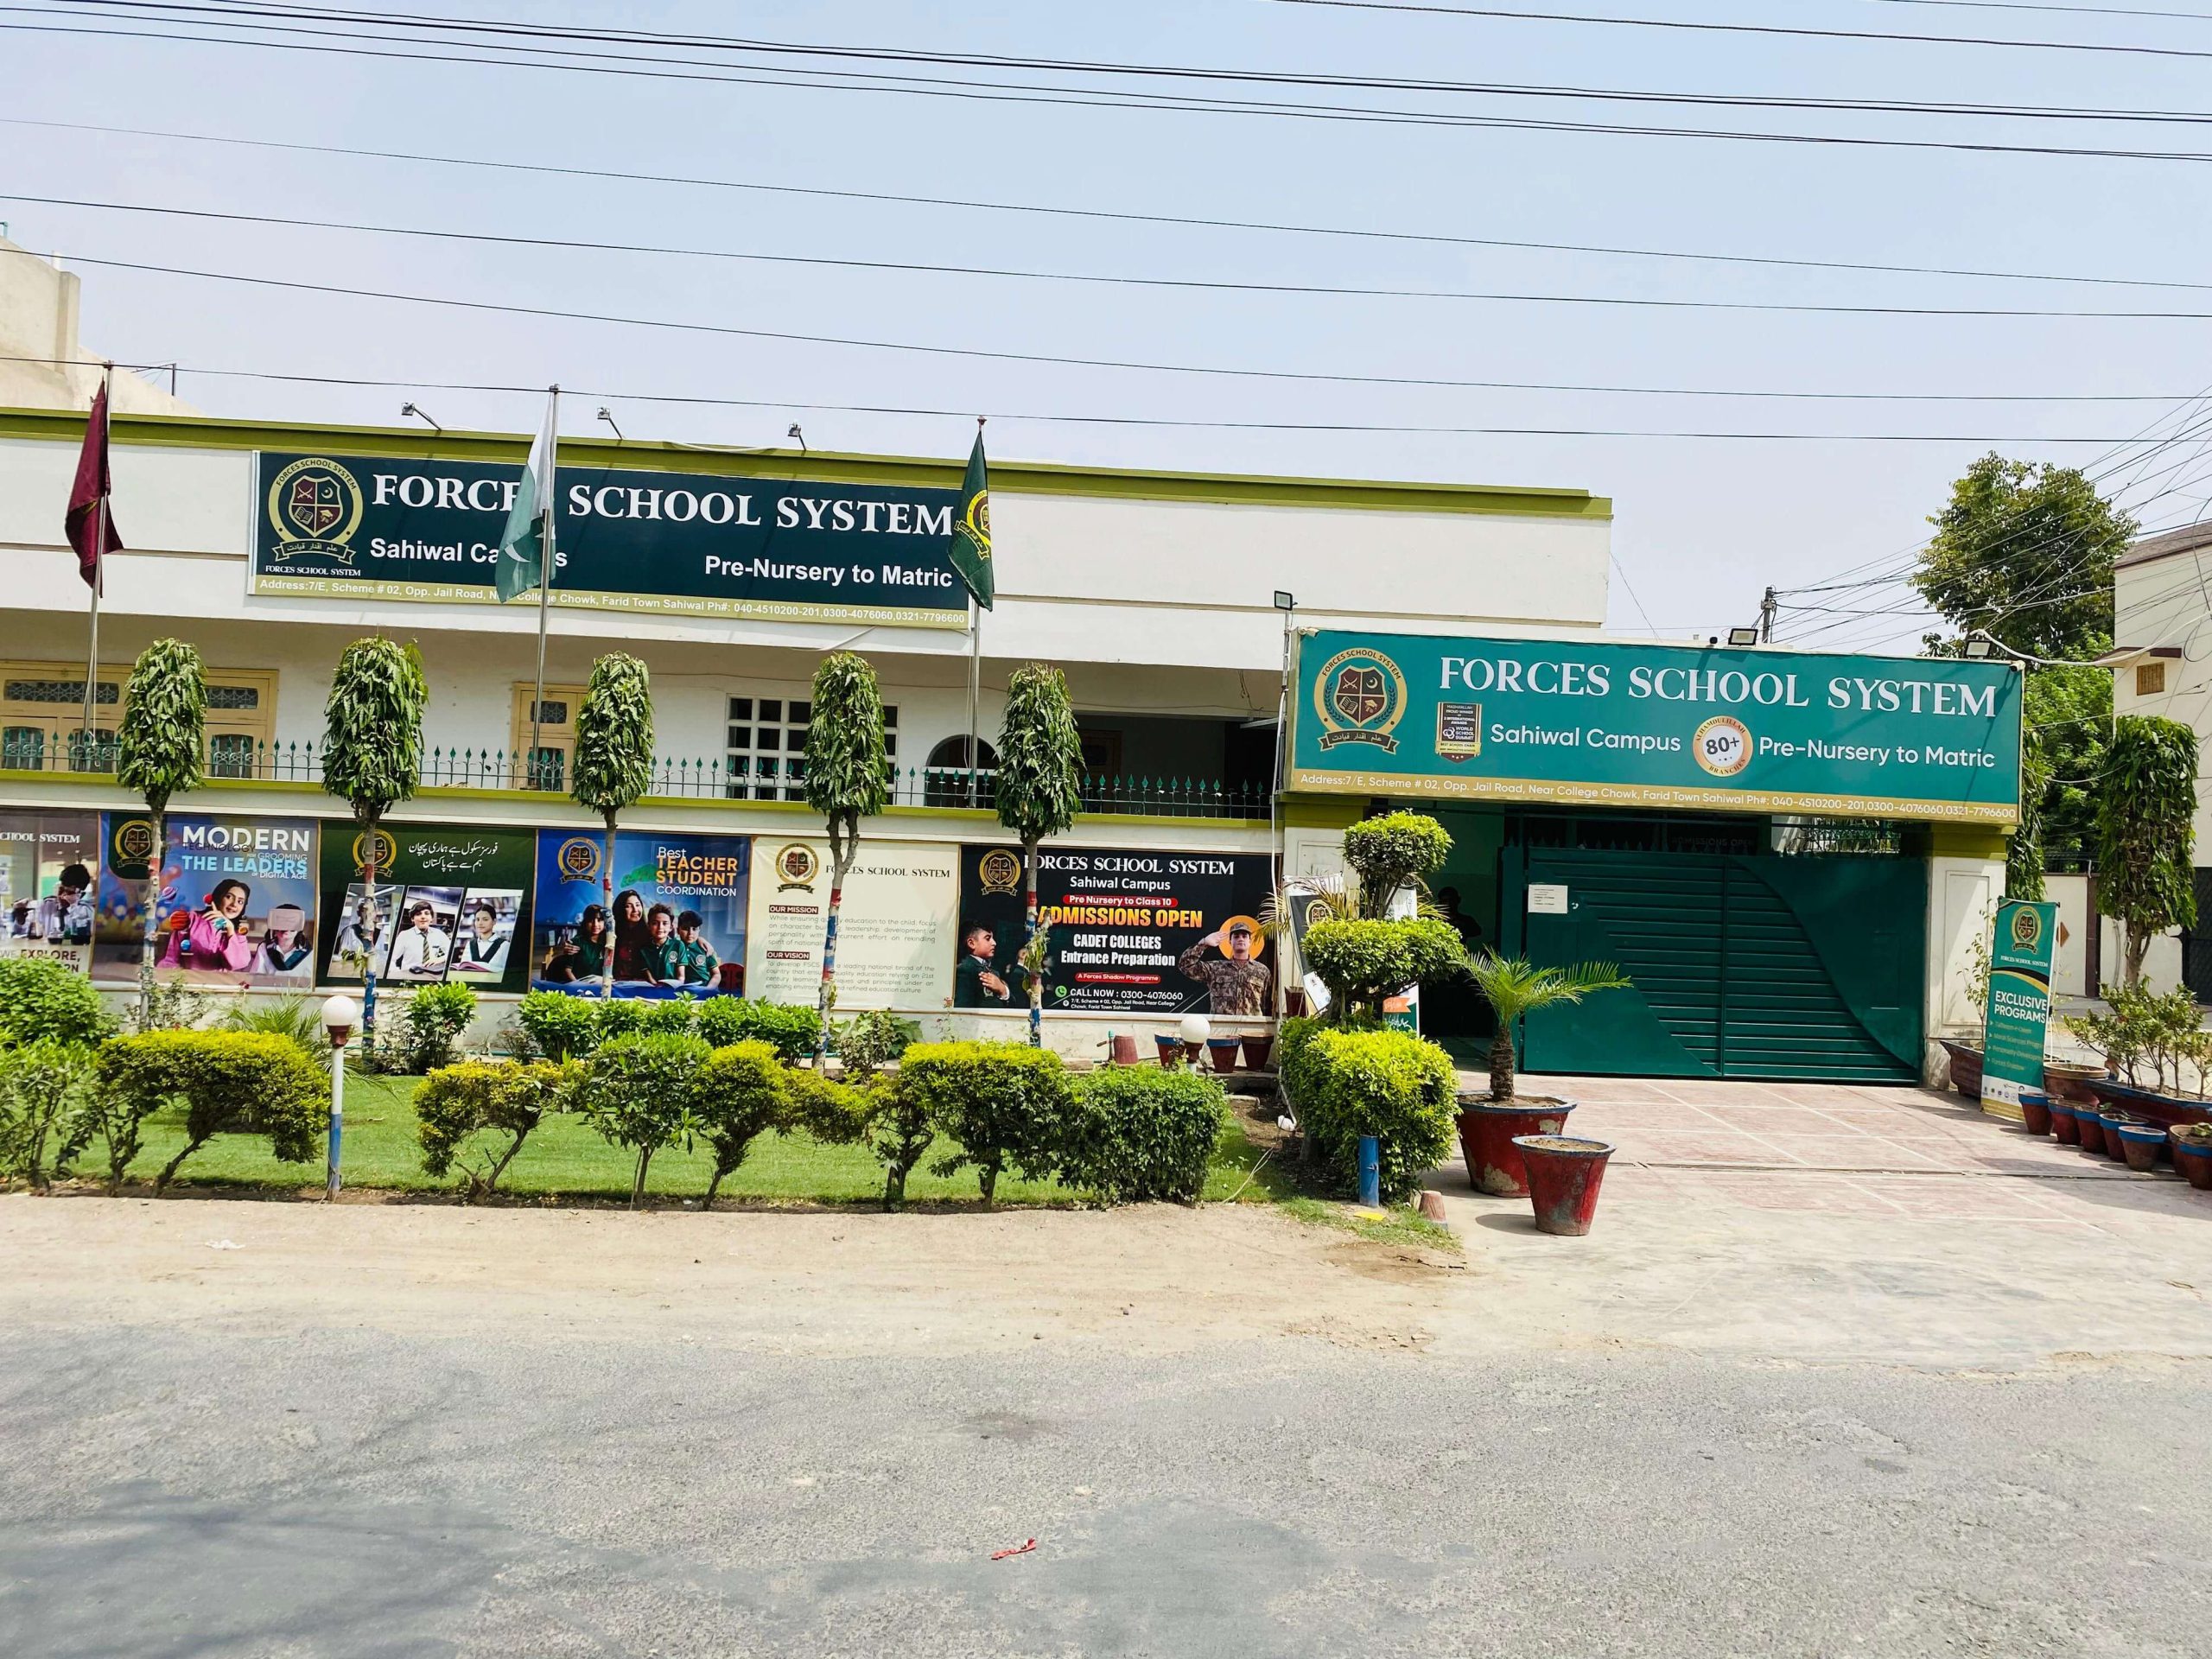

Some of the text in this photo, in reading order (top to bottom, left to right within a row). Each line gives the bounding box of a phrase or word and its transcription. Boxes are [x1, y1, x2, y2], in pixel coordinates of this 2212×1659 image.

[276, 459, 357, 490] FORCES SCHOOL SYSTEM
[372, 474, 521, 512] FORCE
[568, 484, 761, 526] SCHOOL
[776, 496, 954, 537] SYSTEM
[370, 537, 568, 567] Sahiwal Cas
[265, 565, 361, 576] FORCES SCHOOL SYSTEM
[704, 555, 953, 588] Pre-Nursery to Matric
[259, 580, 328, 593] Address:7/E,
[331, 582, 375, 594] Scheme
[377, 585, 385, 594] #
[386, 585, 403, 596] 02,
[405, 587, 431, 598] Opp.
[434, 588, 452, 598] Jail
[454, 588, 486, 601] Road,
[560, 594, 599, 605] Chowk,
[602, 595, 629, 607] Farid
[632, 597, 660, 608] Town
[663, 599, 704, 611] Sahiwal
[1321, 649, 1402, 680] FORCES SCHOOL SYSTEM
[1439, 656, 1997, 718] FORCES SCHOOL SYSTEM
[1490, 723, 1681, 754] Sahiwal Campus
[1706, 736, 1740, 755] 80+
[1759, 736, 1996, 768] Pre-Nursery to Matric
[1709, 759, 1745, 774] BRANCHES
[1300, 774, 1366, 787] Address:7/E,
[1369, 777, 1412, 788] Scheme
[1414, 779, 1421, 788] #
[1424, 779, 1440, 791] 02,
[1443, 781, 1469, 793] Opp.
[1473, 782, 1491, 792] Jail
[1495, 783, 1525, 795] Road,
[1529, 785, 1554, 795] Near
[1557, 785, 1599, 799] College
[1601, 787, 1640, 800] Chowk,
[1643, 790, 1670, 800] Farid
[1673, 791, 1700, 802] Town
[1702, 792, 1744, 804] Sahiwal
[0, 832, 80, 843] CHOOL SYSTEM
[182, 825, 310, 851] MODERN
[182, 842, 257, 853] TECHNOLOGY
[658, 847, 687, 858] Best
[181, 855, 308, 874] THE LEADERS
[657, 856, 738, 871] TEACHER
[826, 865, 950, 878] FES SCHOOL SYSTEM
[1094, 857, 1162, 873] SCHOOL
[1168, 860, 1235, 875] SYSTEM
[656, 870, 737, 886] STUDENT
[1070, 876, 1171, 892] Sahiwal Campus
[657, 886, 737, 897] COORDINATION
[1069, 895, 1084, 904] Pre
[1086, 895, 1122, 906] Nursery
[1135, 897, 1160, 906] Class
[1038, 906, 1203, 928] ADMISSIONS OPEN
[1073, 934, 1161, 950] CADET COLLEGES
[1061, 950, 1176, 966] Entrance Preparation
[1121, 990, 1183, 1000] 0300-4076060
[1995, 990, 2047, 1011] EXCLUSIVE
[1994, 1004, 2046, 1024] PROGRAMS
